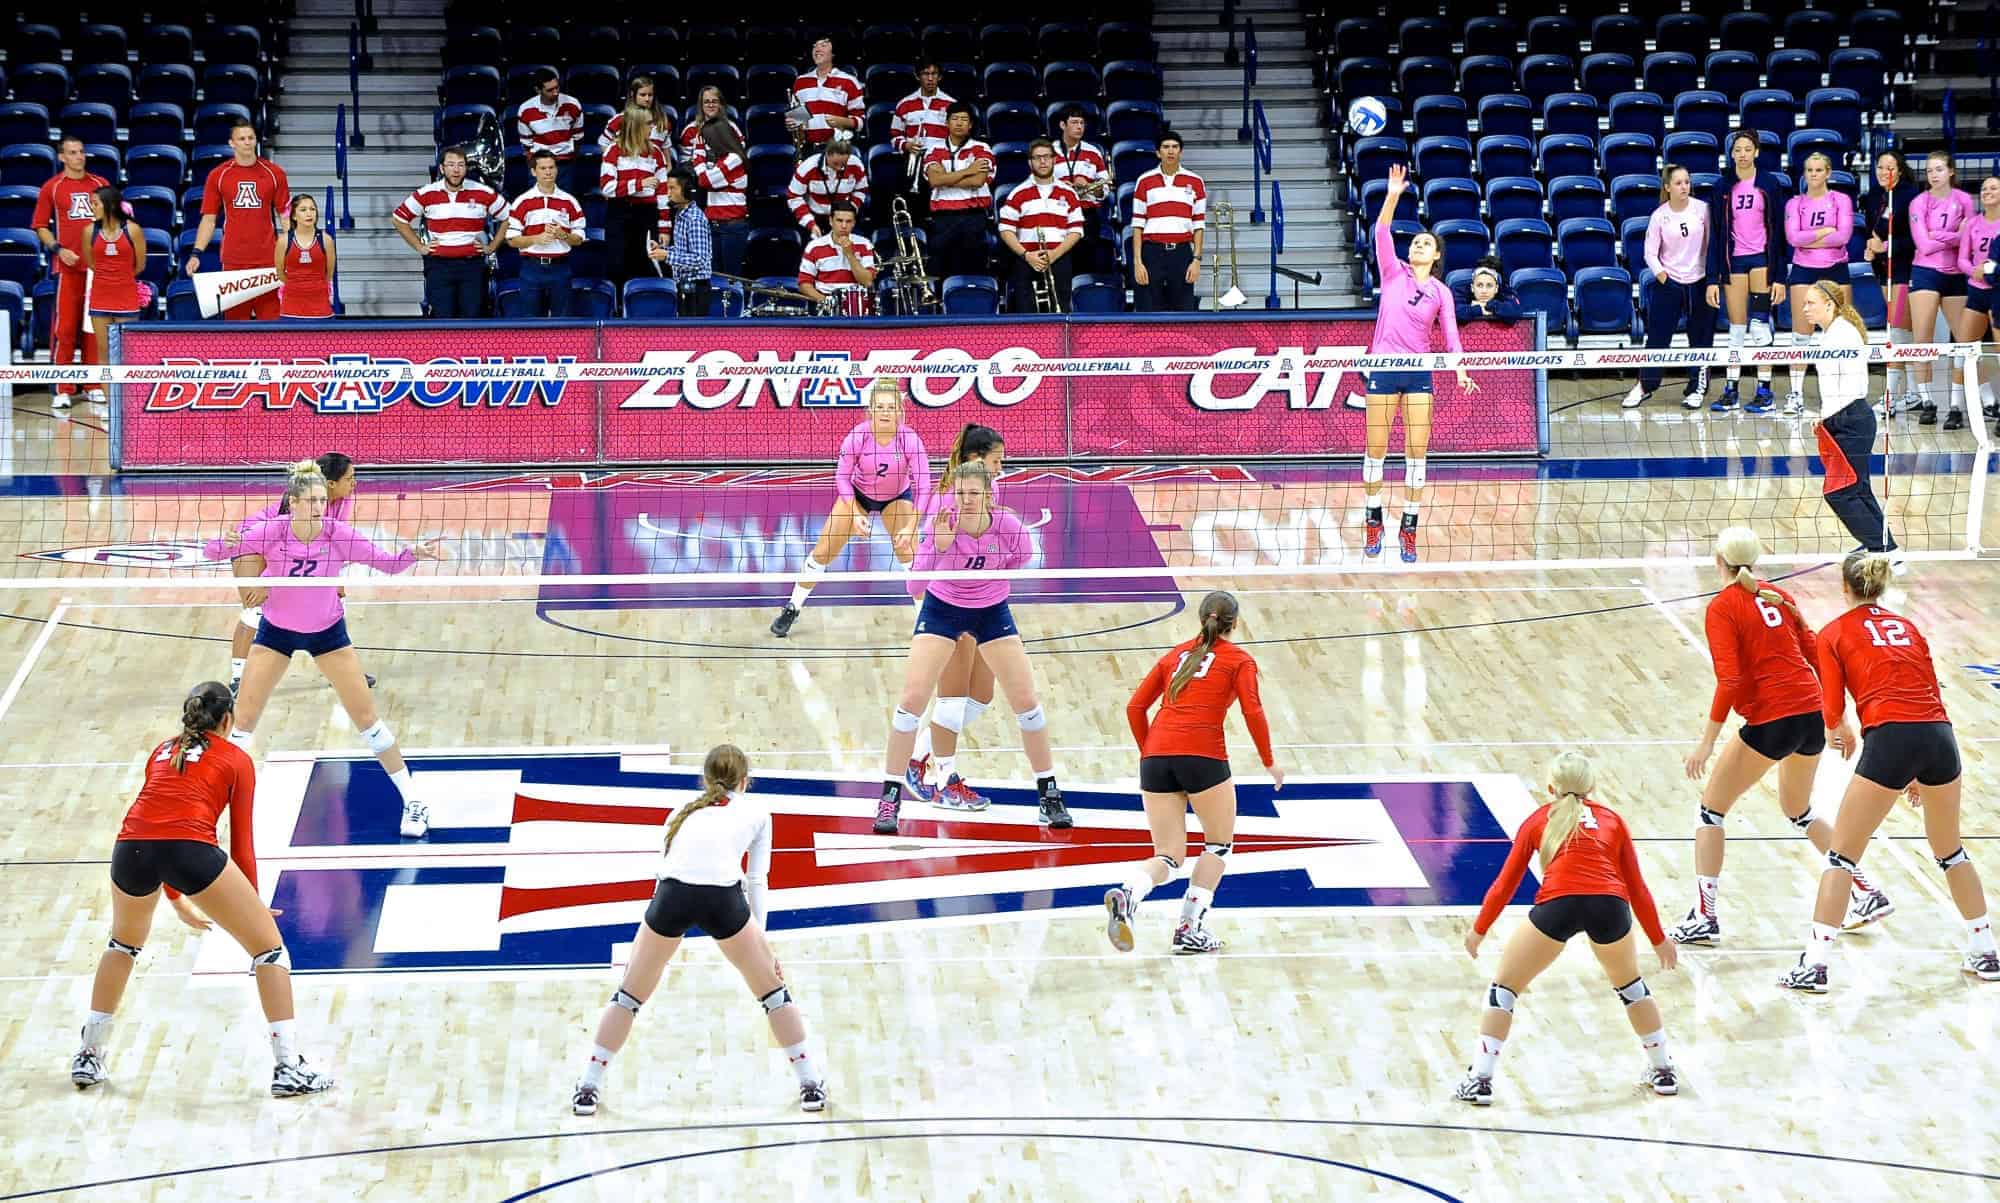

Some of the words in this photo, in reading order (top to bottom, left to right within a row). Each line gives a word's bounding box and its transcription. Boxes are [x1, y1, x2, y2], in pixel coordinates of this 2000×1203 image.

[235, 182, 262, 208] A
[1736, 195, 1754, 210] 33
[67, 192, 97, 221] A
[1810, 211, 1826, 227] 15
[1941, 213, 1949, 228] 7
[1680, 222, 1689, 238] 5
[1408, 289, 1425, 306] 3
[1188, 345, 1371, 411] CAT
[424, 464, 1259, 491] ARIZNA
[876, 463, 889, 477] 2
[288, 559, 318, 577] 22
[964, 555, 986, 569] 18
[1755, 596, 1784, 628] 6
[1863, 618, 1912, 647] 12
